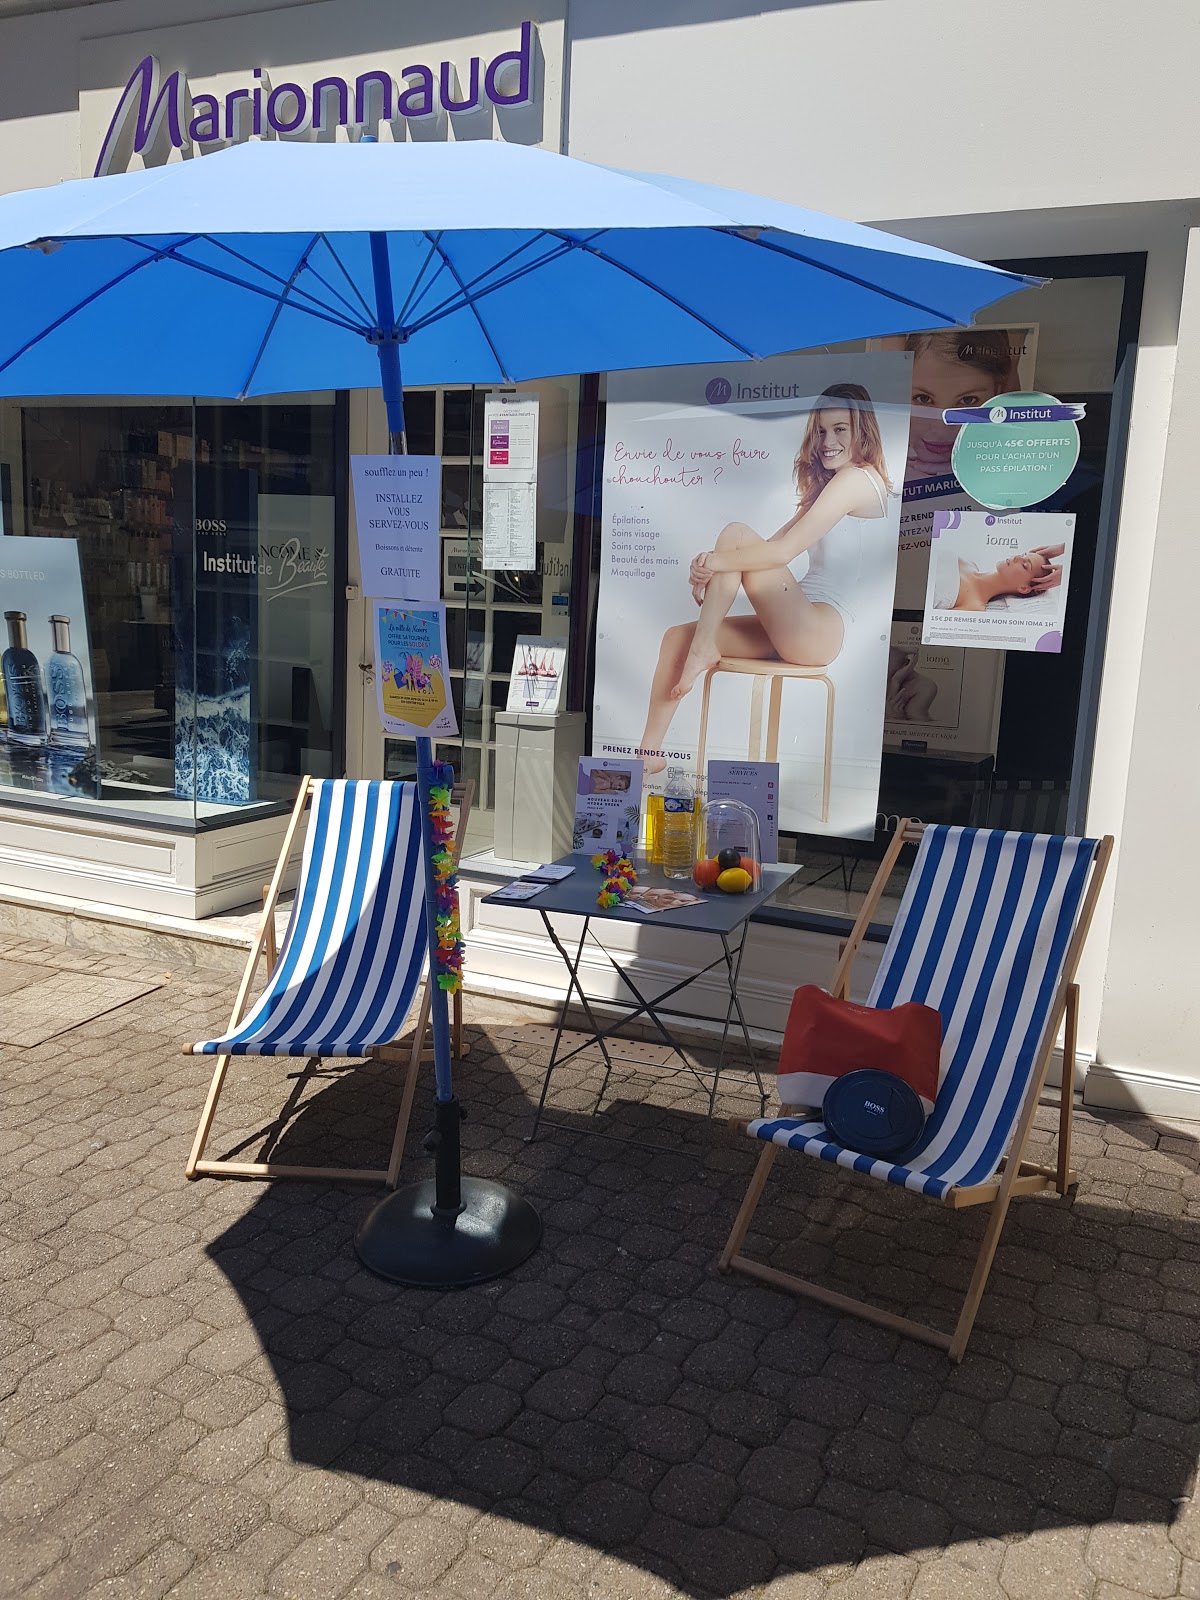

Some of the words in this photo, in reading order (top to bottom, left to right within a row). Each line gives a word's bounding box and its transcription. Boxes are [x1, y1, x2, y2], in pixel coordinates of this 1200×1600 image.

[95, 21, 531, 177] Marionnaud
[736, 382, 799, 399] Institut
[1009, 408, 1051, 420] Institut
[1004, 439, 1024, 447] 45€
[1026, 438, 1071, 447] OFFERTS
[614, 441, 657, 461] Envie
[662, 438, 685, 461] de
[690, 449, 726, 460] vous
[732, 438, 770, 466] faire
[976, 453, 1000, 461] POUR
[1002, 452, 1036, 460] L'ACHAT
[1038, 451, 1060, 459] D'UN
[365, 467, 396, 477] soufflez
[397, 469, 407, 477] un
[409, 469, 423, 479] peu
[1003, 463, 1047, 472] ÉPILATION
[612, 465, 703, 487] chouchouter
[713, 467, 724, 485] ?
[375, 493, 423, 503] INSTALLEZ
[388, 507, 411, 516] VOUS
[612, 513, 650, 525] Épilations
[997, 517, 1022, 525] Institut
[195, 519, 227, 532] BOSS
[369, 520, 429, 530] SERVEZ-VOUS
[612, 529, 632, 538] Soins
[634, 529, 660, 540] visage
[611, 542, 632, 551] Soins
[634, 544, 656, 553] corps
[203, 551, 257, 574] Institut
[258, 561, 273, 575] de
[611, 555, 638, 564] Beauté
[640, 555, 654, 565] des
[656, 557, 679, 565] mains
[7, 569, 45, 581] BOTTLED
[380, 567, 421, 578] GRATUITE
[611, 569, 656, 579] Maquillage
[602, 745, 632, 755] PRENEZ
[634, 748, 691, 760] RENDEZ-VOUS
[864, 1100, 886, 1113] BOSS
